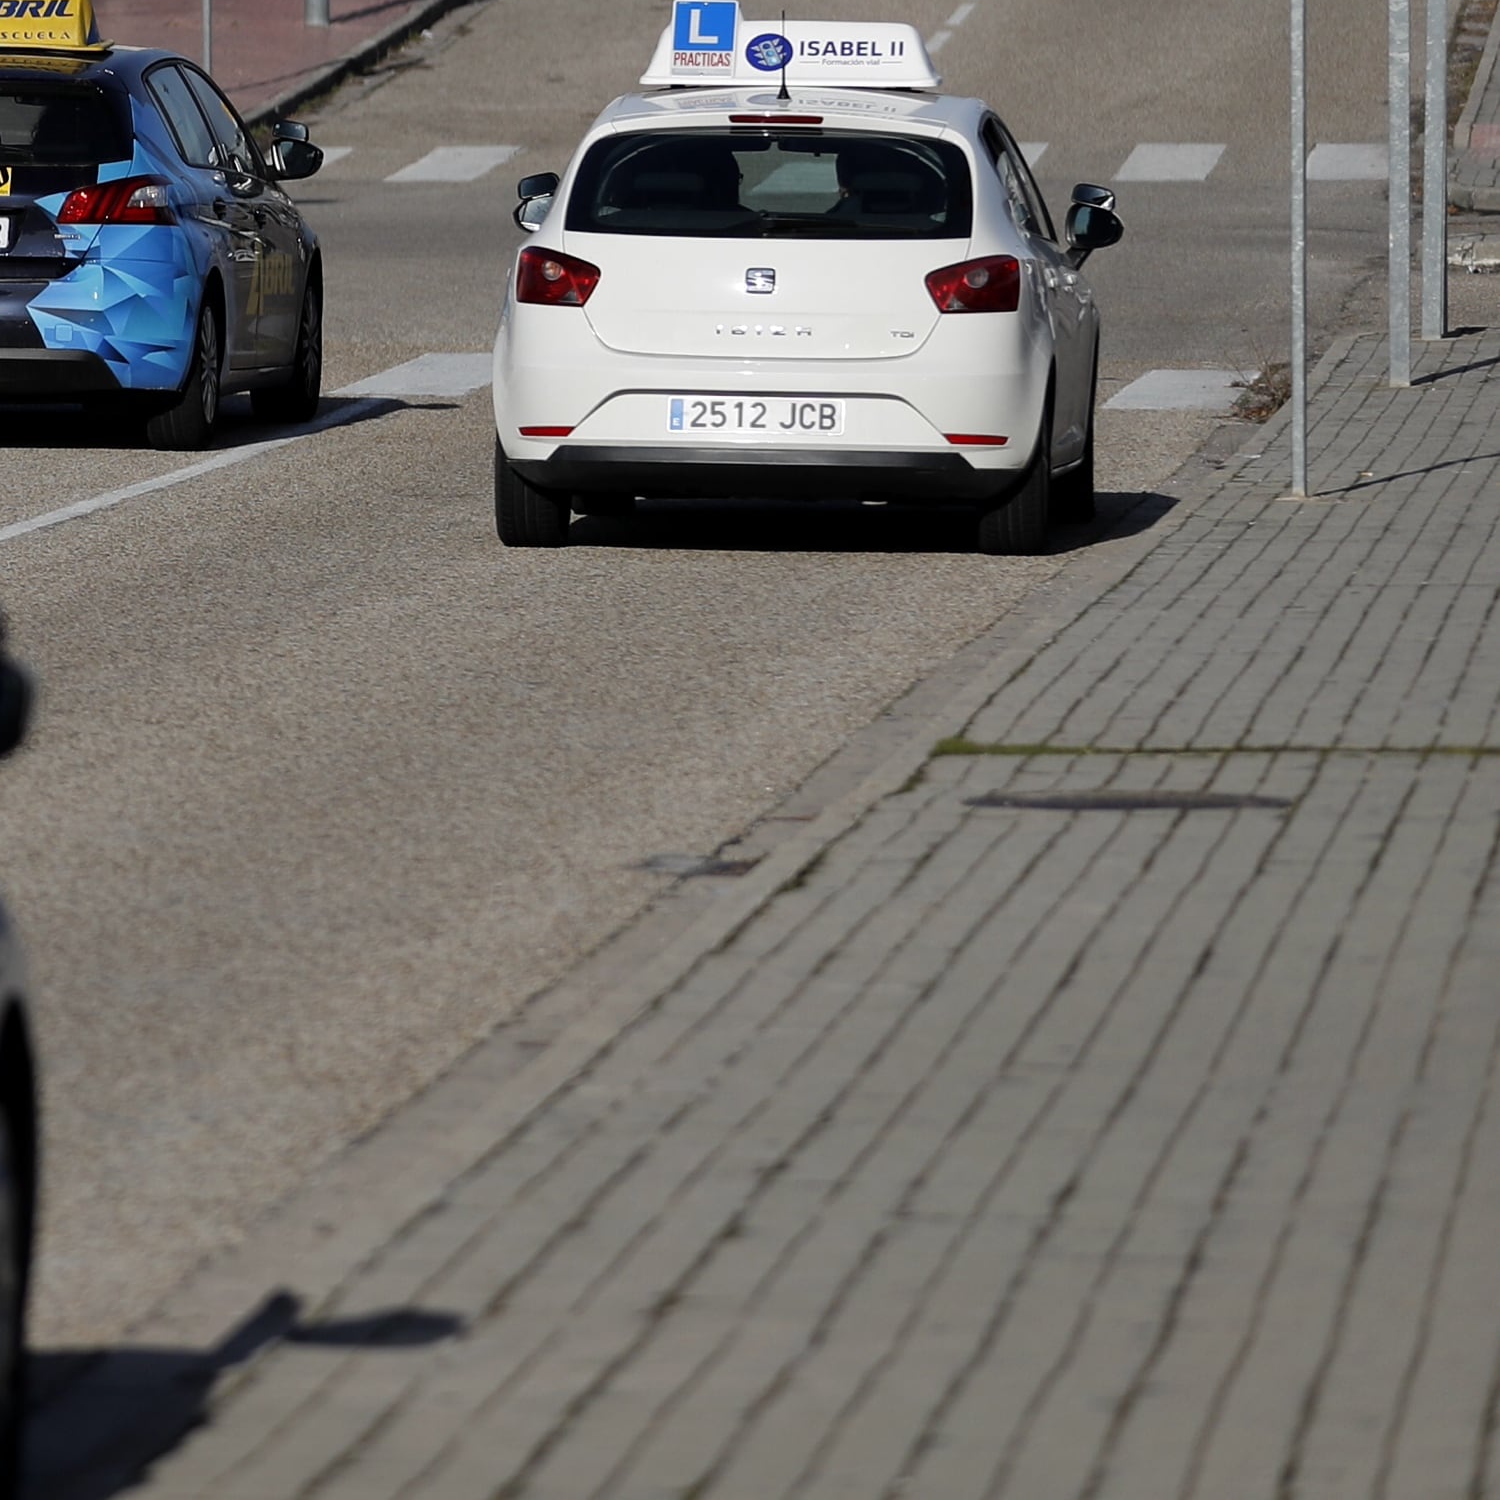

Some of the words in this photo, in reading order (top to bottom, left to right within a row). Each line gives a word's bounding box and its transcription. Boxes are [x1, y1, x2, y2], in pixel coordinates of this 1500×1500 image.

[689, 8, 719, 45] L
[799, 40, 883, 57] ISABEL
[890, 41, 905, 57] II
[673, 51, 731, 68] PRACTICAS
[821, 57, 866, 67] Formación
[866, 58, 881, 67] vial
[672, 417, 681, 427] E
[690, 401, 768, 429] 2512
[779, 402, 837, 431] JCB
